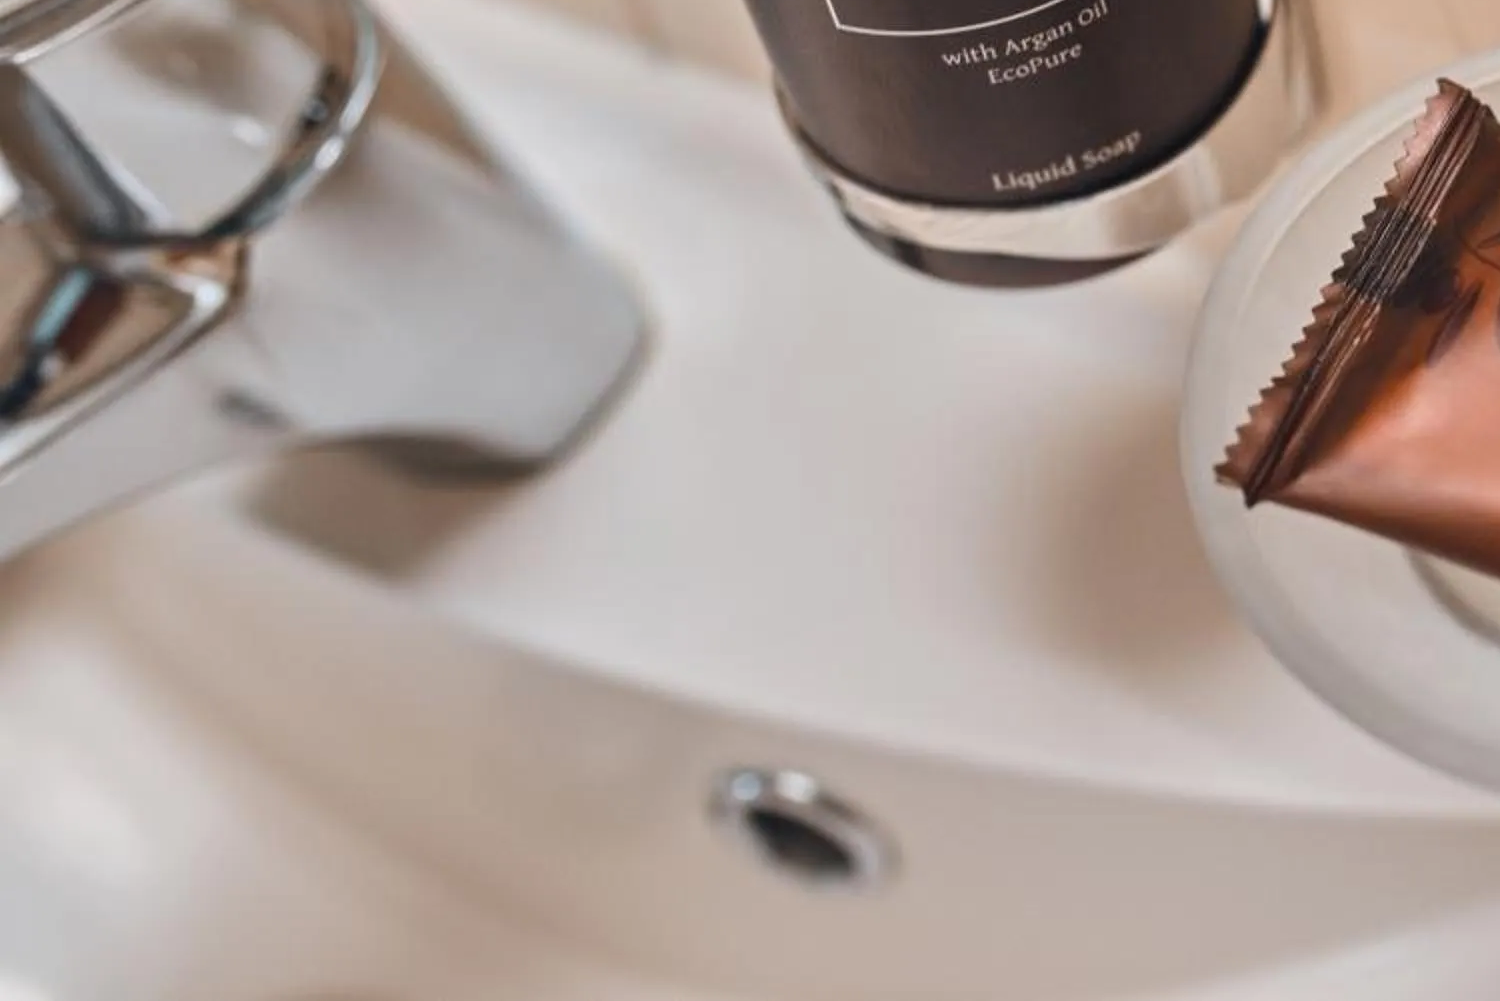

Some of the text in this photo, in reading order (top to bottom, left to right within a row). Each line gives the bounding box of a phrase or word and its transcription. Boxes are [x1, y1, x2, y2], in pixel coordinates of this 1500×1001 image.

[941, 42, 998, 66] with
[1004, 21, 1074, 56] Argan
[987, 42, 1083, 85] EcoPure
[991, 130, 1142, 192] Liquid Soap
